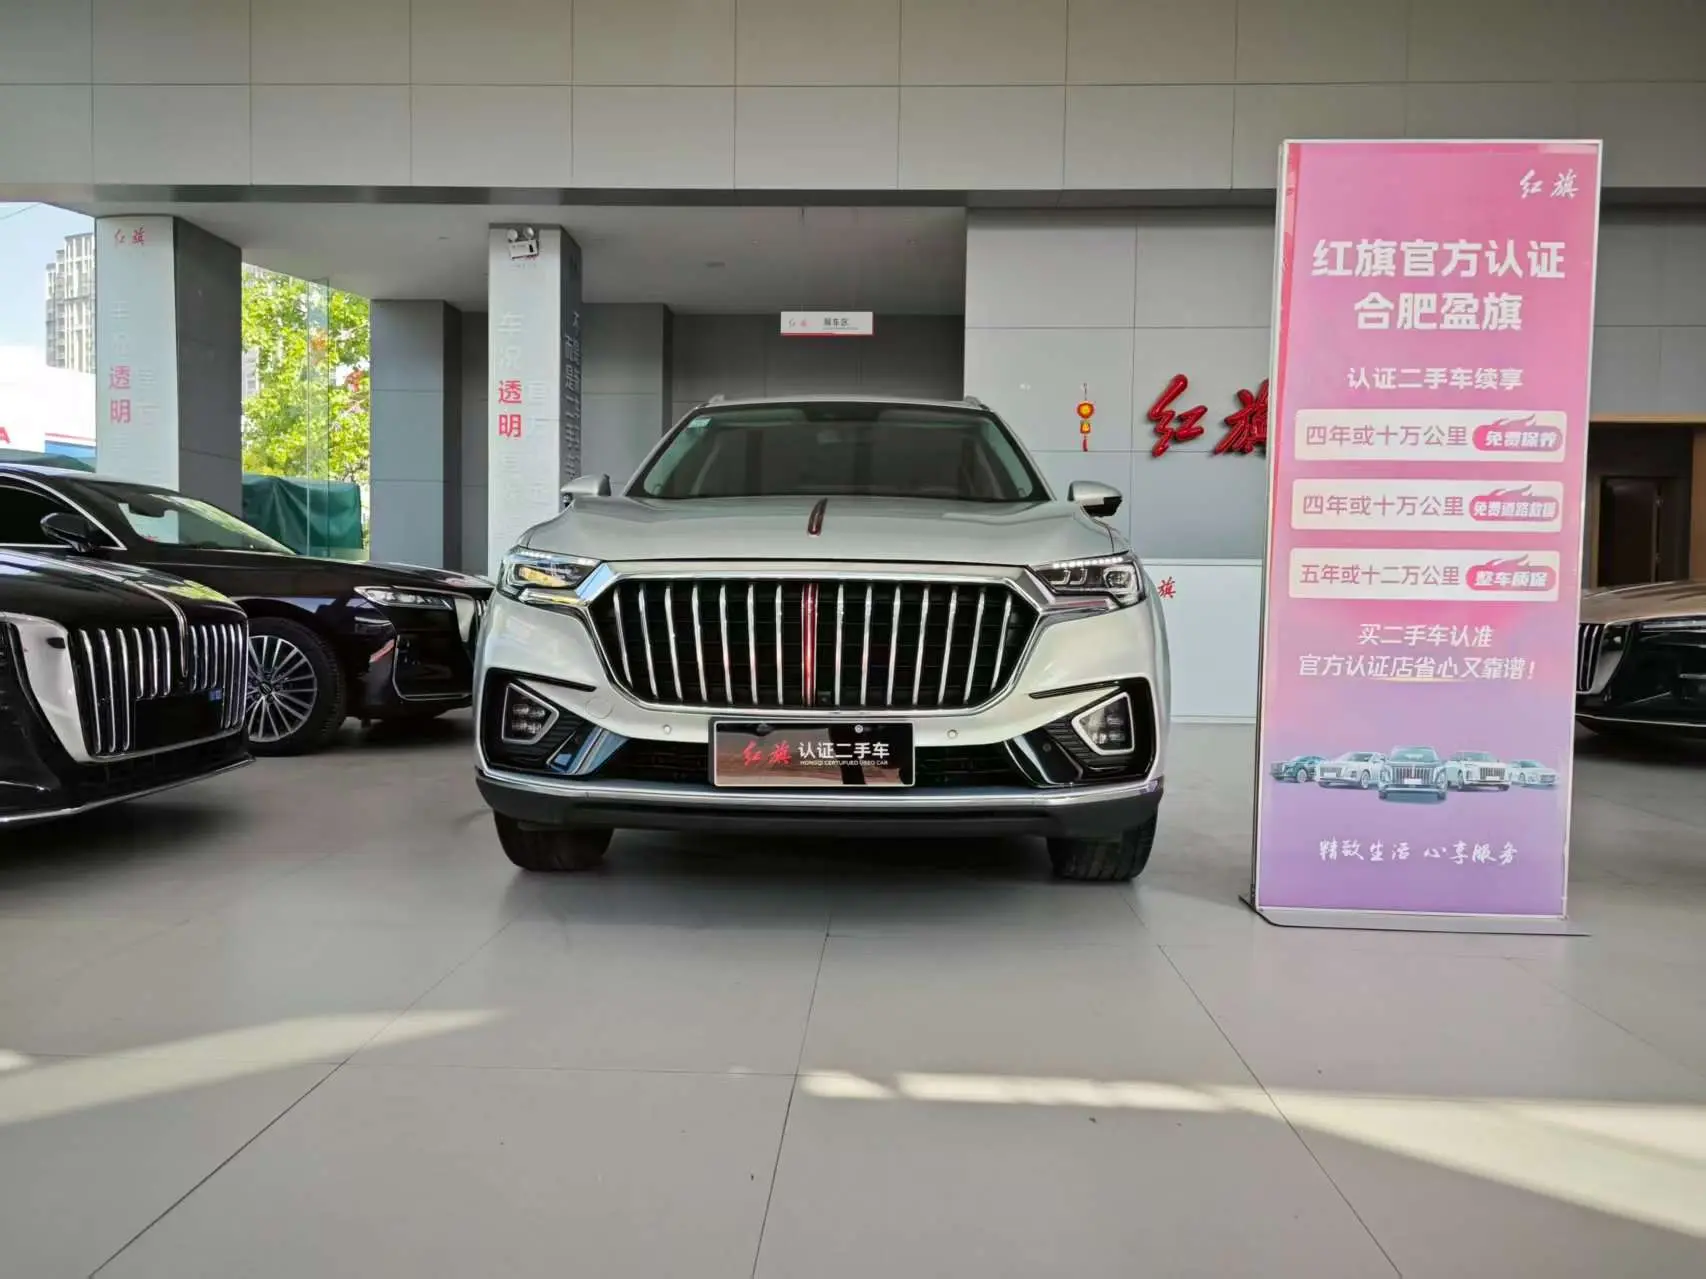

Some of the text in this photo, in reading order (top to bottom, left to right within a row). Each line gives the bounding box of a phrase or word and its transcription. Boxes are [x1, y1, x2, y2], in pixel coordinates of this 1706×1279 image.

[1519, 168, 1580, 199] 红旗
[1311, 237, 1567, 279] 红旗官方认证
[1353, 290, 1524, 332] 合肥盈旗
[1347, 367, 1524, 392] 认证二手车续享
[1306, 424, 1469, 447] 四年或十万公里
[1302, 494, 1465, 517] 四年或十万公里
[1300, 563, 1460, 587] 五年或十二万公里
[1358, 623, 1495, 648] 买二手车认准
[743, 740, 890, 766] 红旗 认证二手车
[1423, 839, 1519, 866] 心享服务
